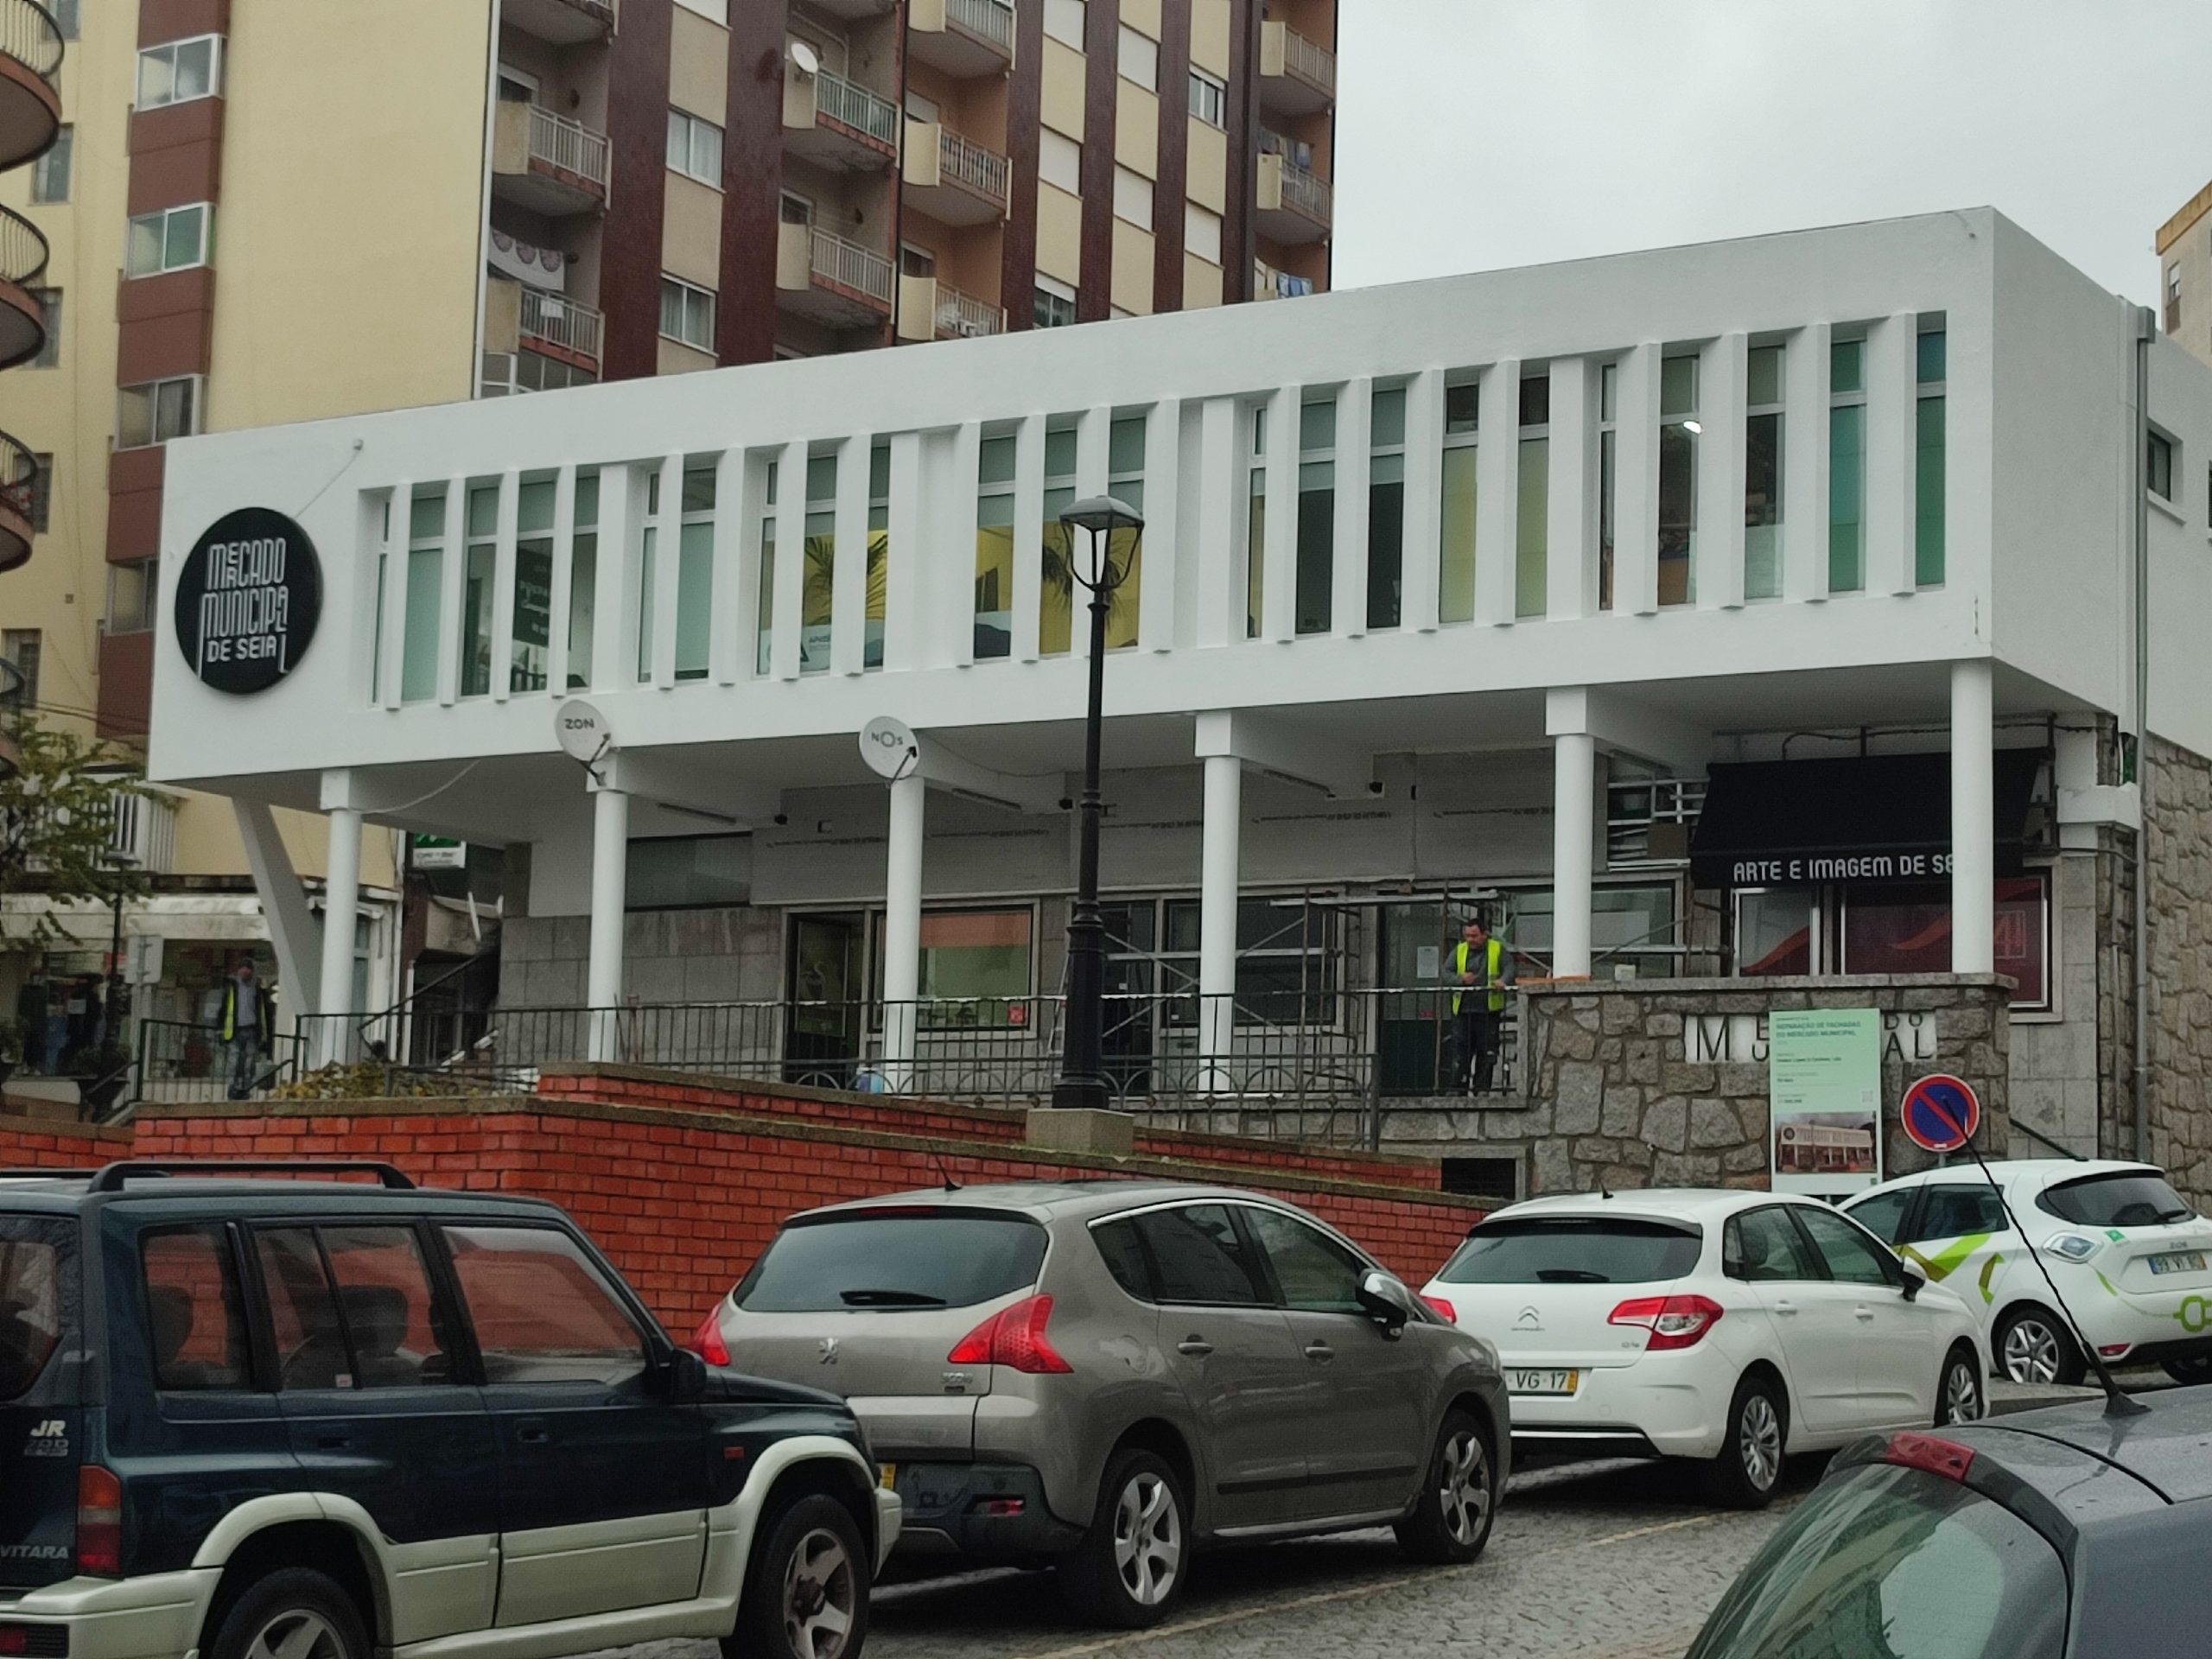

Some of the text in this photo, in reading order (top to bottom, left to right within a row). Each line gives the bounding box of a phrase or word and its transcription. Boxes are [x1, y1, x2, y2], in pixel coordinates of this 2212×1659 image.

[207, 635, 277, 663] DE SEIA
[564, 717, 594, 730] ZON
[871, 731, 904, 747] NOS
[1733, 861, 1782, 882] ARTE
[1789, 860, 1802, 880] E
[1808, 856, 1892, 879] IMAGEM
[1899, 855, 1926, 875] DE
[1516, 1370, 1567, 1389] VG 17
[30, 1420, 66, 1437] JR
[0, 1545, 69, 1559] VITARA
